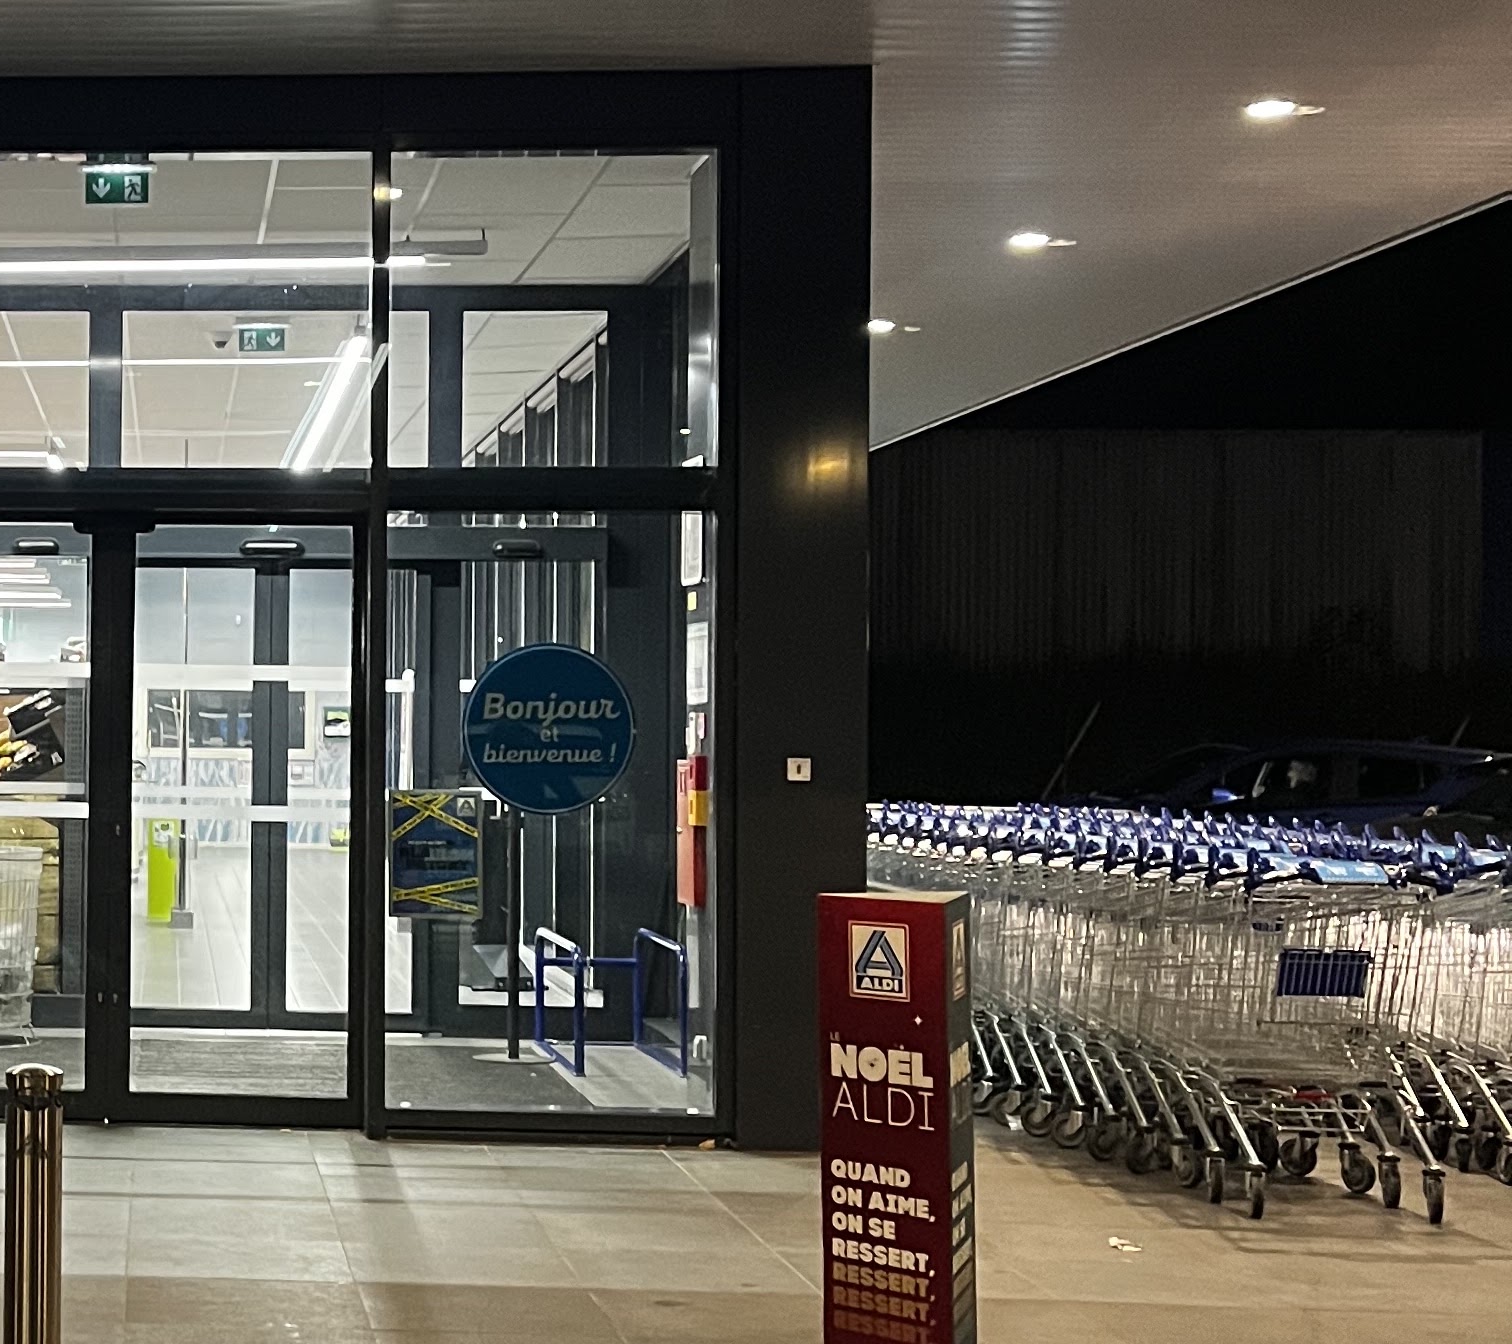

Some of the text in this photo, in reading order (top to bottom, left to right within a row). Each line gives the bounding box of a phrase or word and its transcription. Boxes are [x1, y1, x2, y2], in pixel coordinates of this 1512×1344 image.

[483, 692, 621, 726] Bonjour
[540, 727, 559, 742] et
[483, 743, 603, 763] bienvenue
[860, 977, 900, 992] ALDI
[830, 1032, 840, 1041] LE
[832, 1081, 935, 1131] ALDI
[831, 1159, 911, 1188] QUAND
[831, 1185, 936, 1222] ON AIME,
[832, 1211, 896, 1240] ON SE
[832, 1238, 935, 1277] RESSERT,
[833, 1260, 936, 1302] RESSERT,
[833, 1286, 937, 1326] RESSERT,
